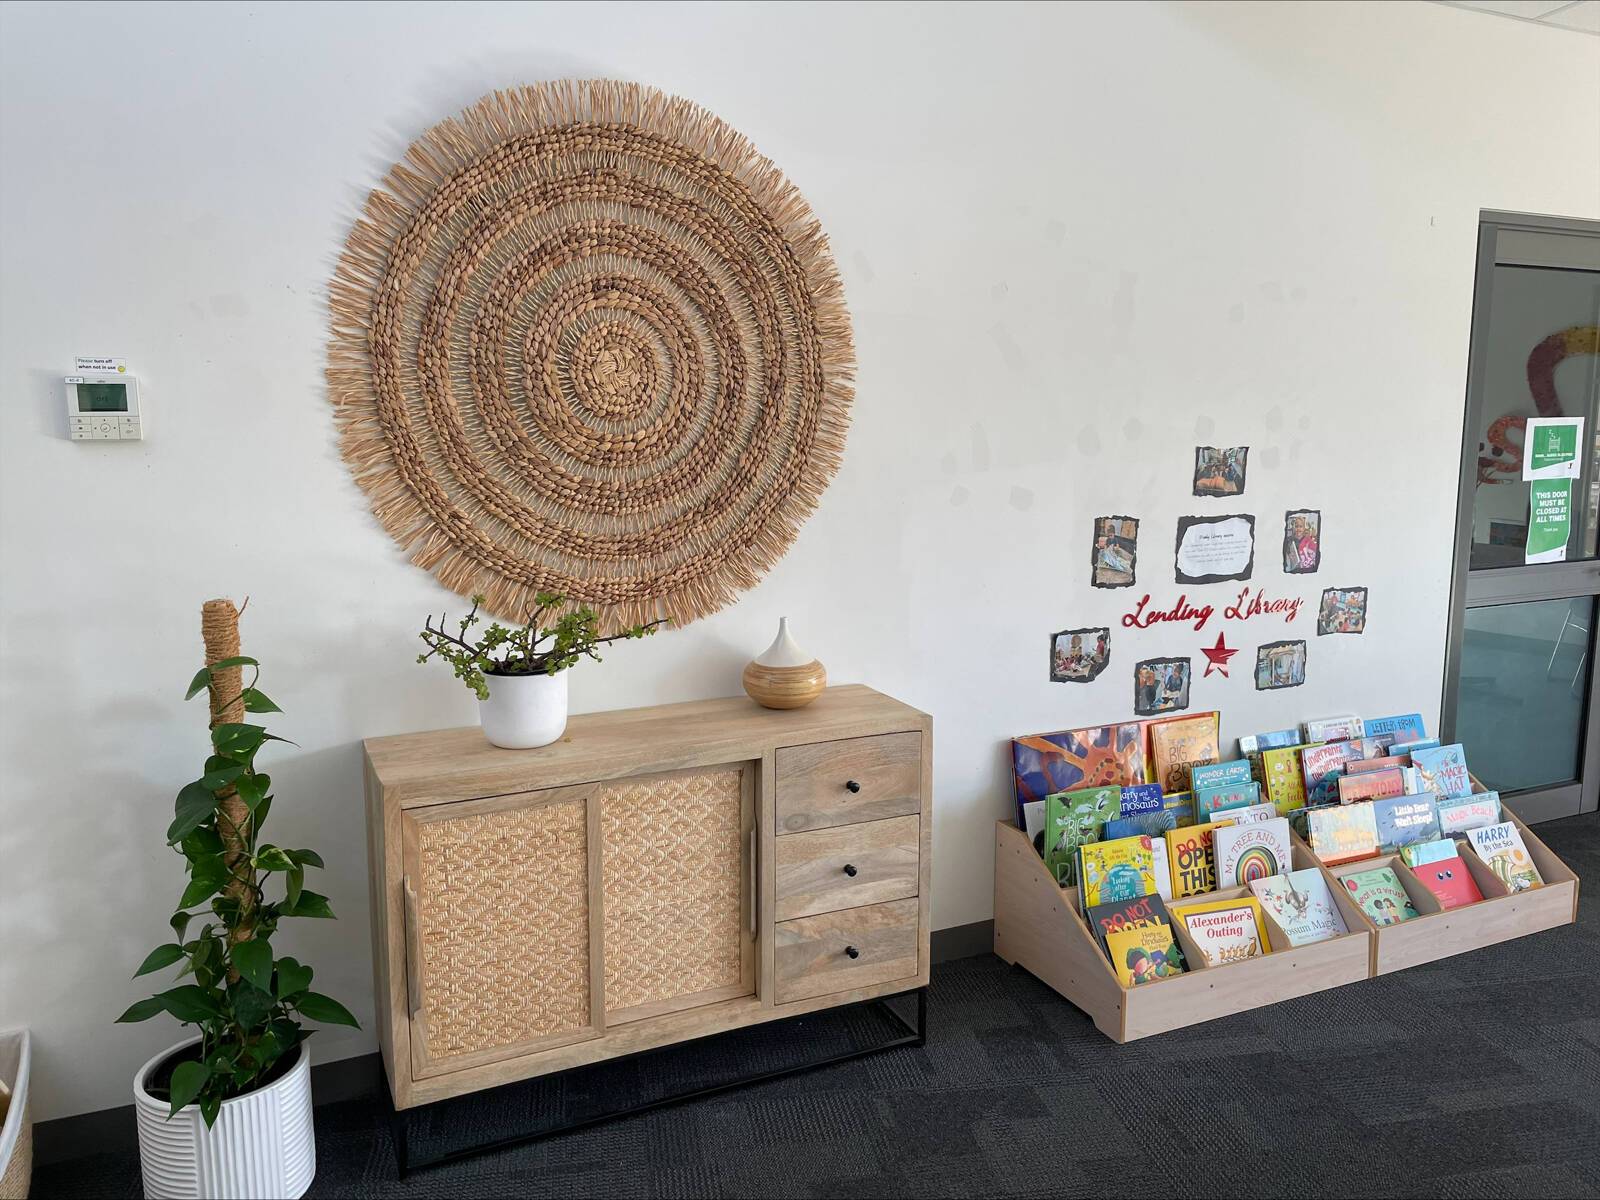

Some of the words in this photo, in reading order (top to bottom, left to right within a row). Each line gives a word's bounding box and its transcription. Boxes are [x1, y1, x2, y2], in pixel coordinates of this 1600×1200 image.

[1536, 515, 1548, 523] ALL
[1549, 514, 1566, 522] TIMES
[1121, 594, 1214, 631] Lending
[1224, 586, 1304, 623] Library
[1168, 745, 1188, 763] BIG
[1199, 769, 1225, 779] WONDER
[1225, 766, 1247, 776] EARTH
[1440, 764, 1467, 778] MAGIC
[1446, 777, 1466, 793] HAT
[1120, 791, 1138, 802] arry
[1121, 797, 1159, 811] inosaurs
[1394, 804, 1413, 816] Little
[1413, 803, 1430, 813] Bear
[1446, 809, 1469, 823] Magic
[1470, 804, 1495, 817] Beach
[1067, 817, 1085, 835] BIG
[1412, 811, 1433, 825] Sleep!
[1477, 825, 1511, 844] HARRY
[1176, 838, 1198, 858] DO
[1224, 857, 1236, 875] MY
[1231, 832, 1254, 854] TREE
[1255, 831, 1276, 846] AND
[1274, 843, 1287, 863] ME
[1483, 844, 1492, 853] By
[1492, 842, 1502, 851] the
[1503, 839, 1514, 848] Sea
[1177, 845, 1216, 870] OPE
[1101, 912, 1126, 934] DO
[1125, 897, 1153, 921] NOT
[1190, 911, 1253, 929] Alexander's
[1206, 925, 1244, 939] Outing
[1311, 918, 1338, 930] Magic
